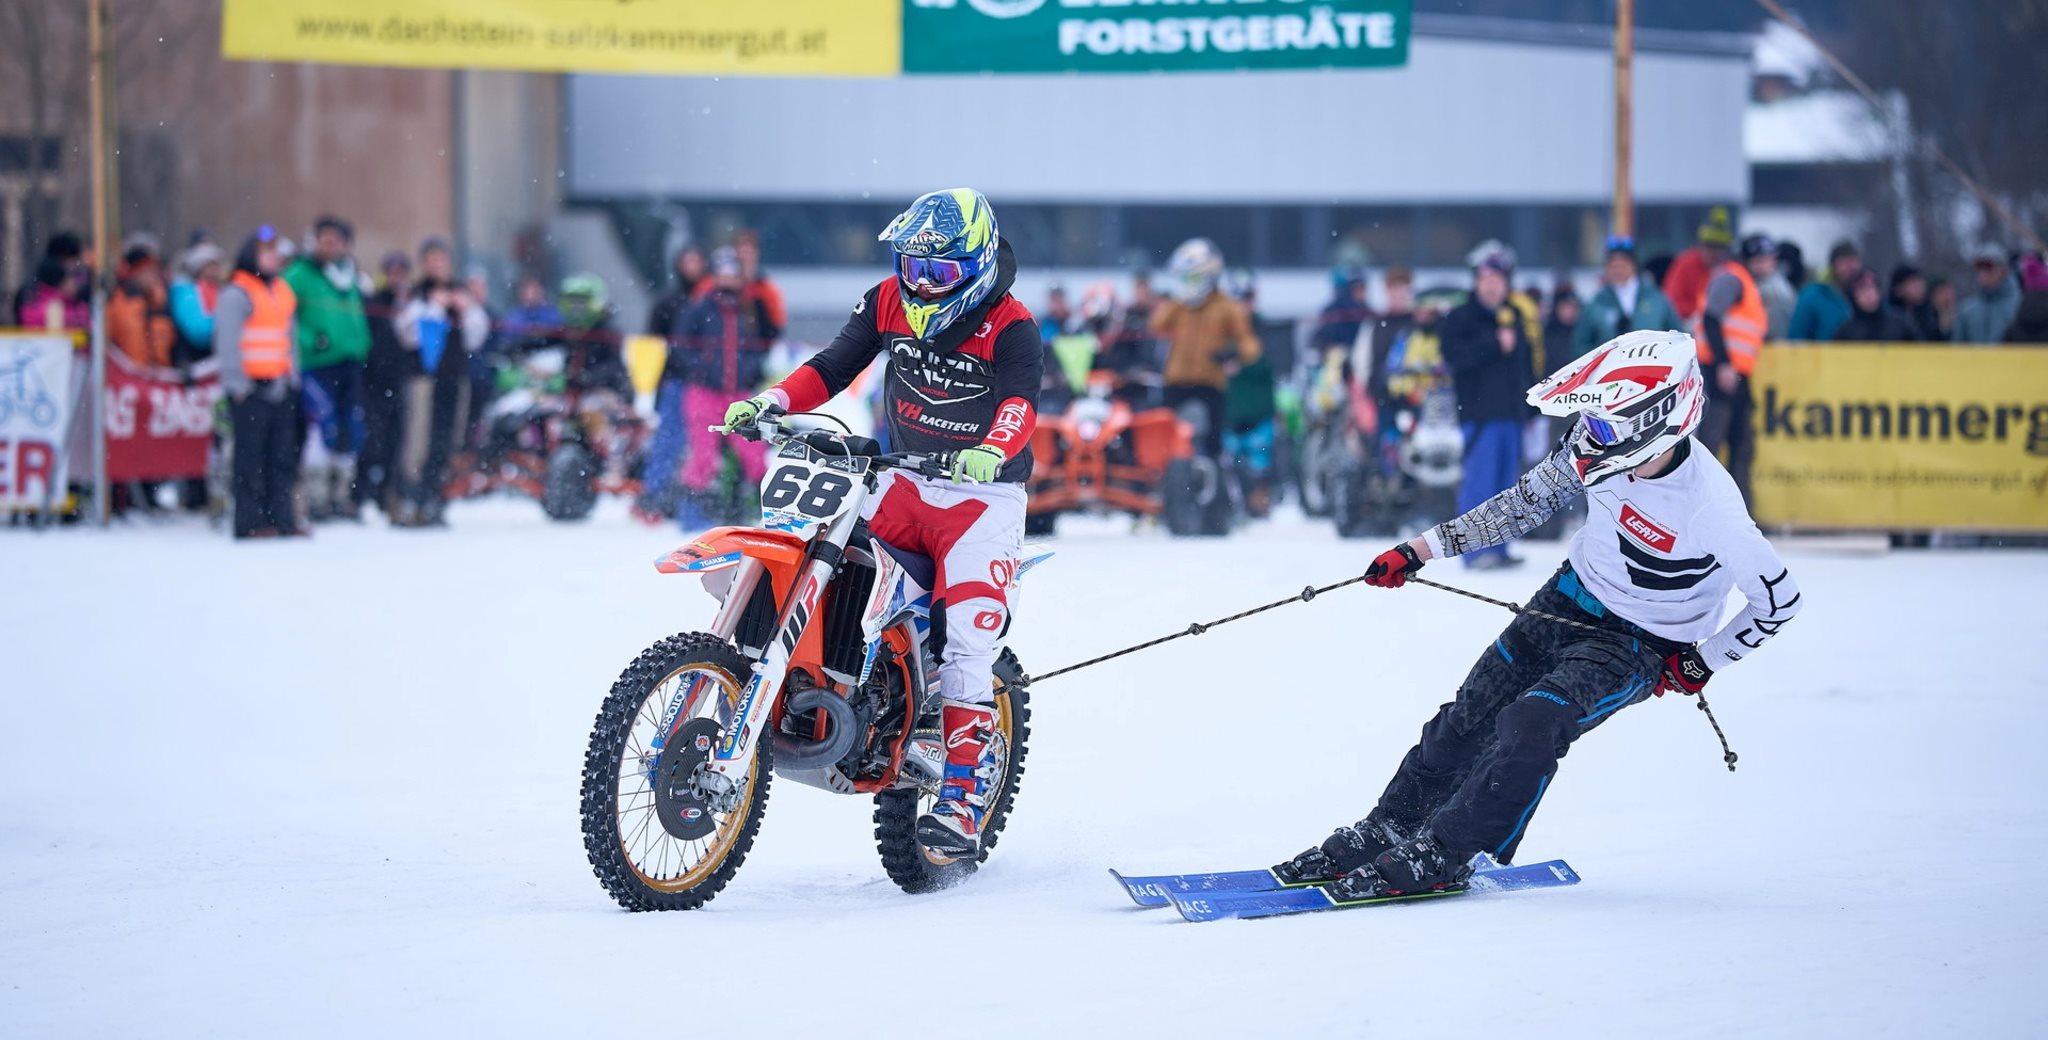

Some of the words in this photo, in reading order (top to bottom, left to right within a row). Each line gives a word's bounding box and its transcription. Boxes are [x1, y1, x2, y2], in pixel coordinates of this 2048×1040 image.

[1058, 6, 1396, 54] FORSTGERÄTE
[896, 398, 924, 421] VH
[918, 414, 980, 433] RACETECH
[1553, 393, 1602, 404] AIROH
[1753, 386, 2048, 456] kammerg
[762, 464, 852, 518] 68
